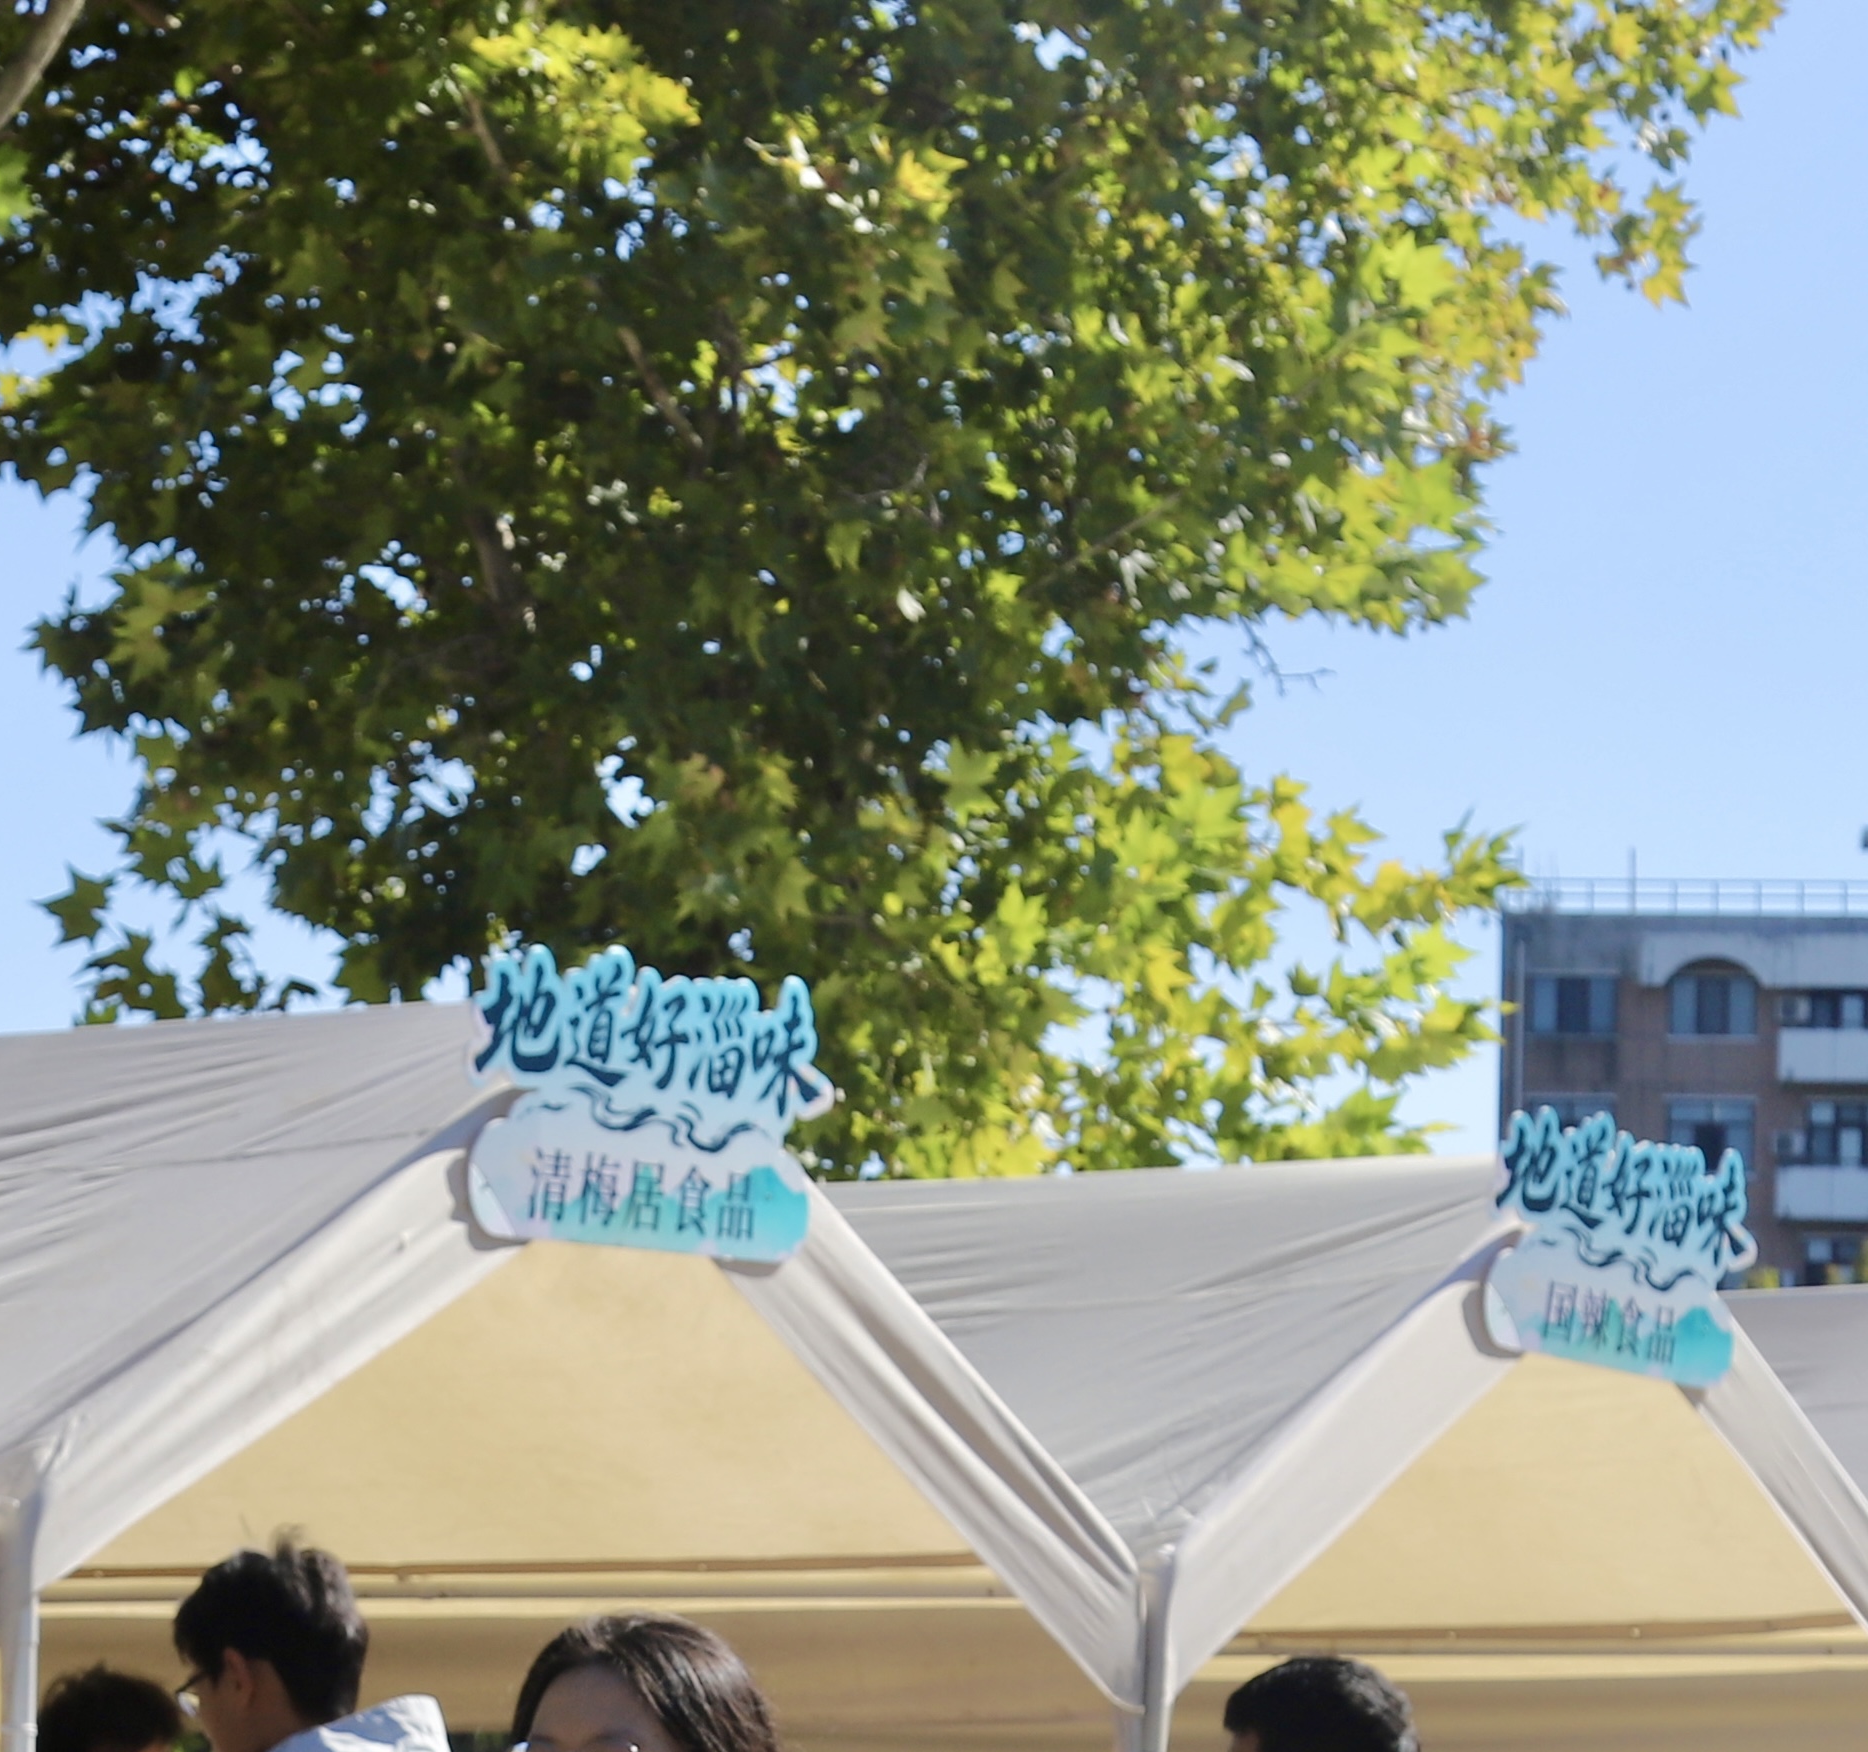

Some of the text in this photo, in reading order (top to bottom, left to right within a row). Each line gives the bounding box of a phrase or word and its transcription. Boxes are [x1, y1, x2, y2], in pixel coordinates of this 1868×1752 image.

[475, 962, 823, 1117] 地道好淄味
[527, 1146, 756, 1241] 清梅居食品
[1495, 1118, 1743, 1266] 地道好淄味
